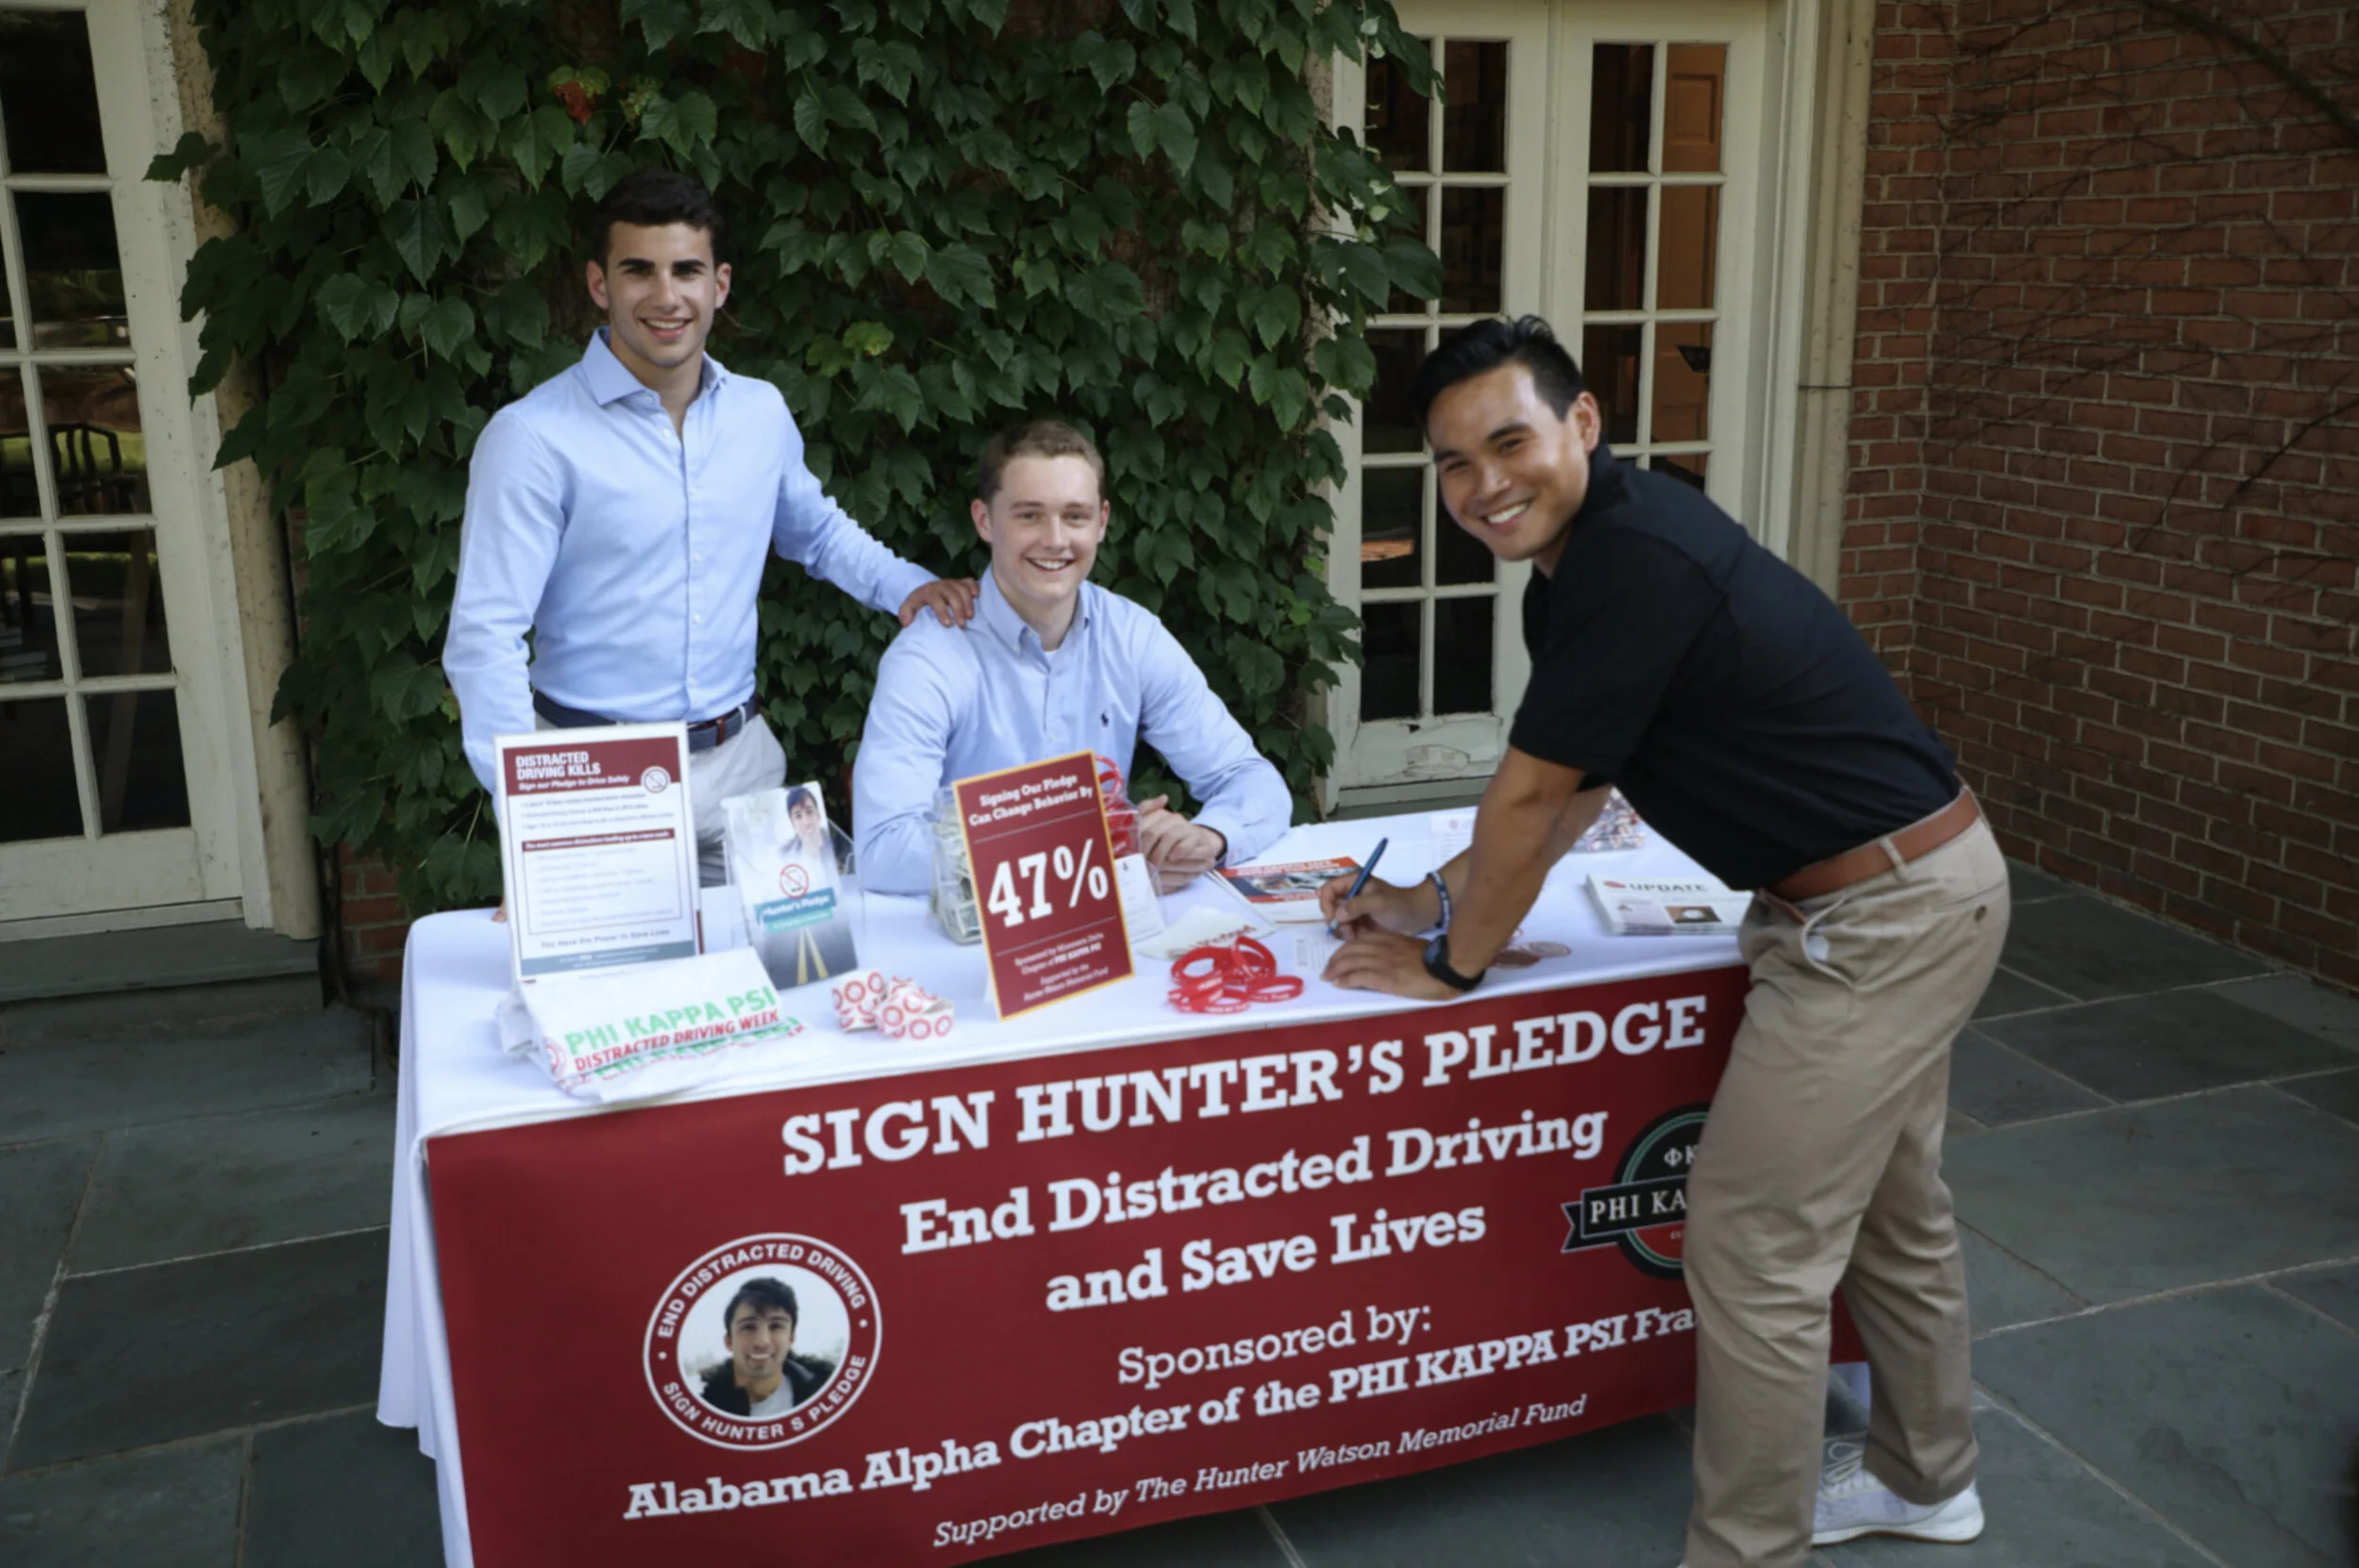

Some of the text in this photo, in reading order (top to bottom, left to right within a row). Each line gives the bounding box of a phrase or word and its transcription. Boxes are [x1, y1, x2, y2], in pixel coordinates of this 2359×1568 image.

[515, 751, 589, 767] DISTRACTED
[516, 762, 601, 780] DRIVING KILLS
[979, 775, 1078, 807] Signing Our Pledge
[968, 786, 1093, 826] Can Change Behavior By
[988, 839, 1109, 927] 47%
[1629, 882, 1708, 892] UPDATE
[563, 1024, 621, 1056] PHI
[623, 1000, 725, 1037] KAPPA
[725, 985, 778, 1015] PSI
[574, 1033, 670, 1072] DISTRACTED
[673, 1019, 736, 1044] DRIVING
[739, 1008, 779, 1030] WEEK
[782, 996, 1705, 1175] SIGN HUNTER'S PLEDGE
[900, 1110, 1607, 1254] End Distracted Driving
[1590, 1193, 1640, 1224] PHI
[658, 1243, 866, 1338] END DISTRACTED DRIVING
[1046, 1207, 1485, 1310] and Save Lives
[1118, 1306, 1430, 1390] Sponsored by:
[624, 1469, 853, 1519] Alabama
[861, 1440, 1001, 1491] Alpha
[1010, 1404, 1191, 1458] Chapter
[1198, 1387, 1244, 1425] of
[1254, 1381, 1320, 1416] the
[1329, 1358, 1409, 1403] PHI
[1415, 1330, 1557, 1387] KAPPA
[1564, 1315, 1628, 1357] PSI
[663, 1380, 701, 1423] SIGN
[701, 1415, 784, 1441] HUNTER
[808, 1354, 866, 1423] PLEDGE
[933, 1393, 1587, 1546] Supported by The Hunter Watson Memorial Fund
